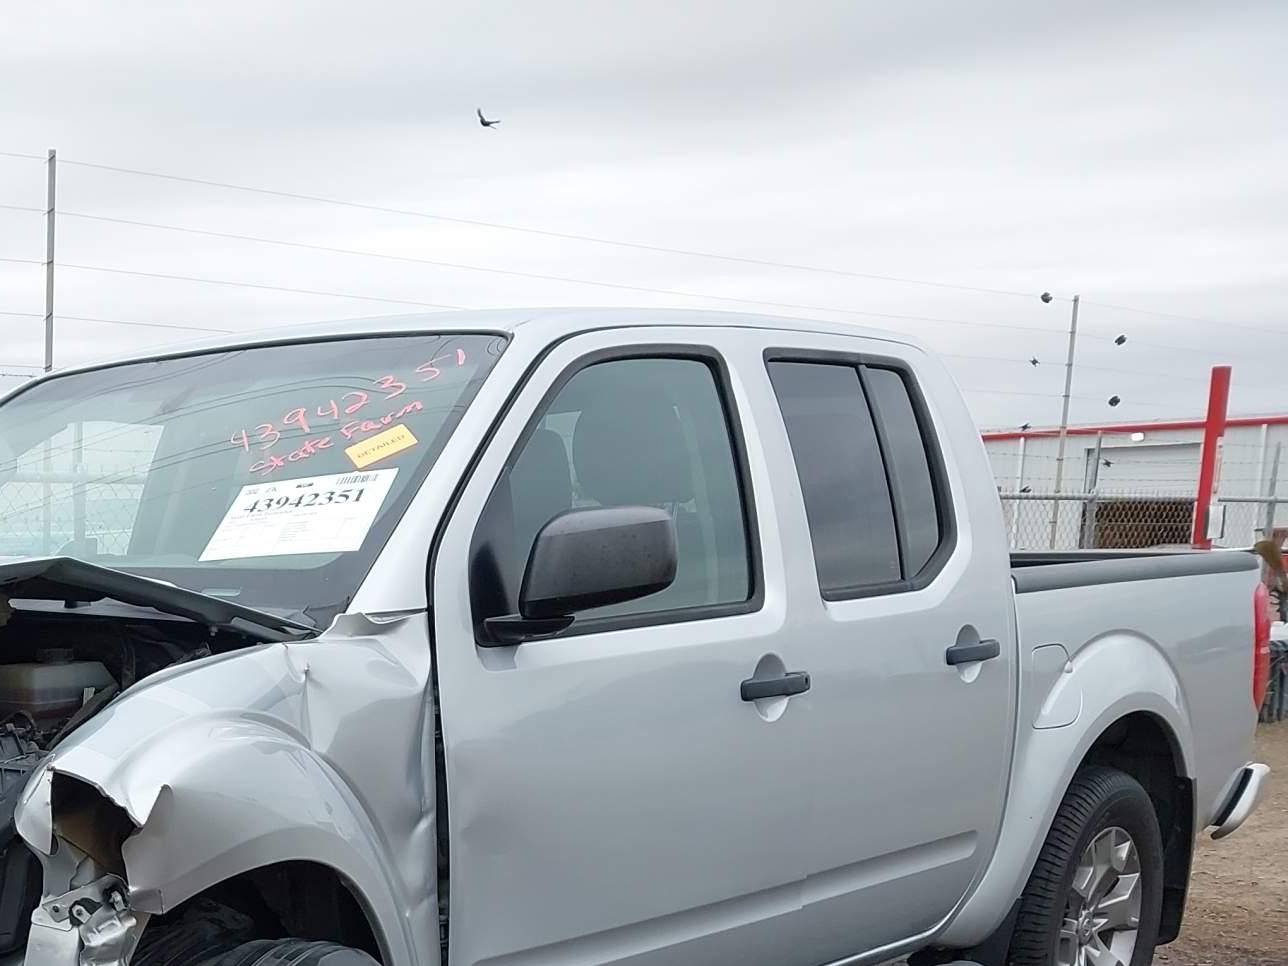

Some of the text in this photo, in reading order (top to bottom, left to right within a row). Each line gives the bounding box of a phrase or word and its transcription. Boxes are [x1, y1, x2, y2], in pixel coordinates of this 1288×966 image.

[231, 348, 466, 452] 43942351
[341, 401, 424, 440] Farm
[243, 488, 365, 513] 43942351
